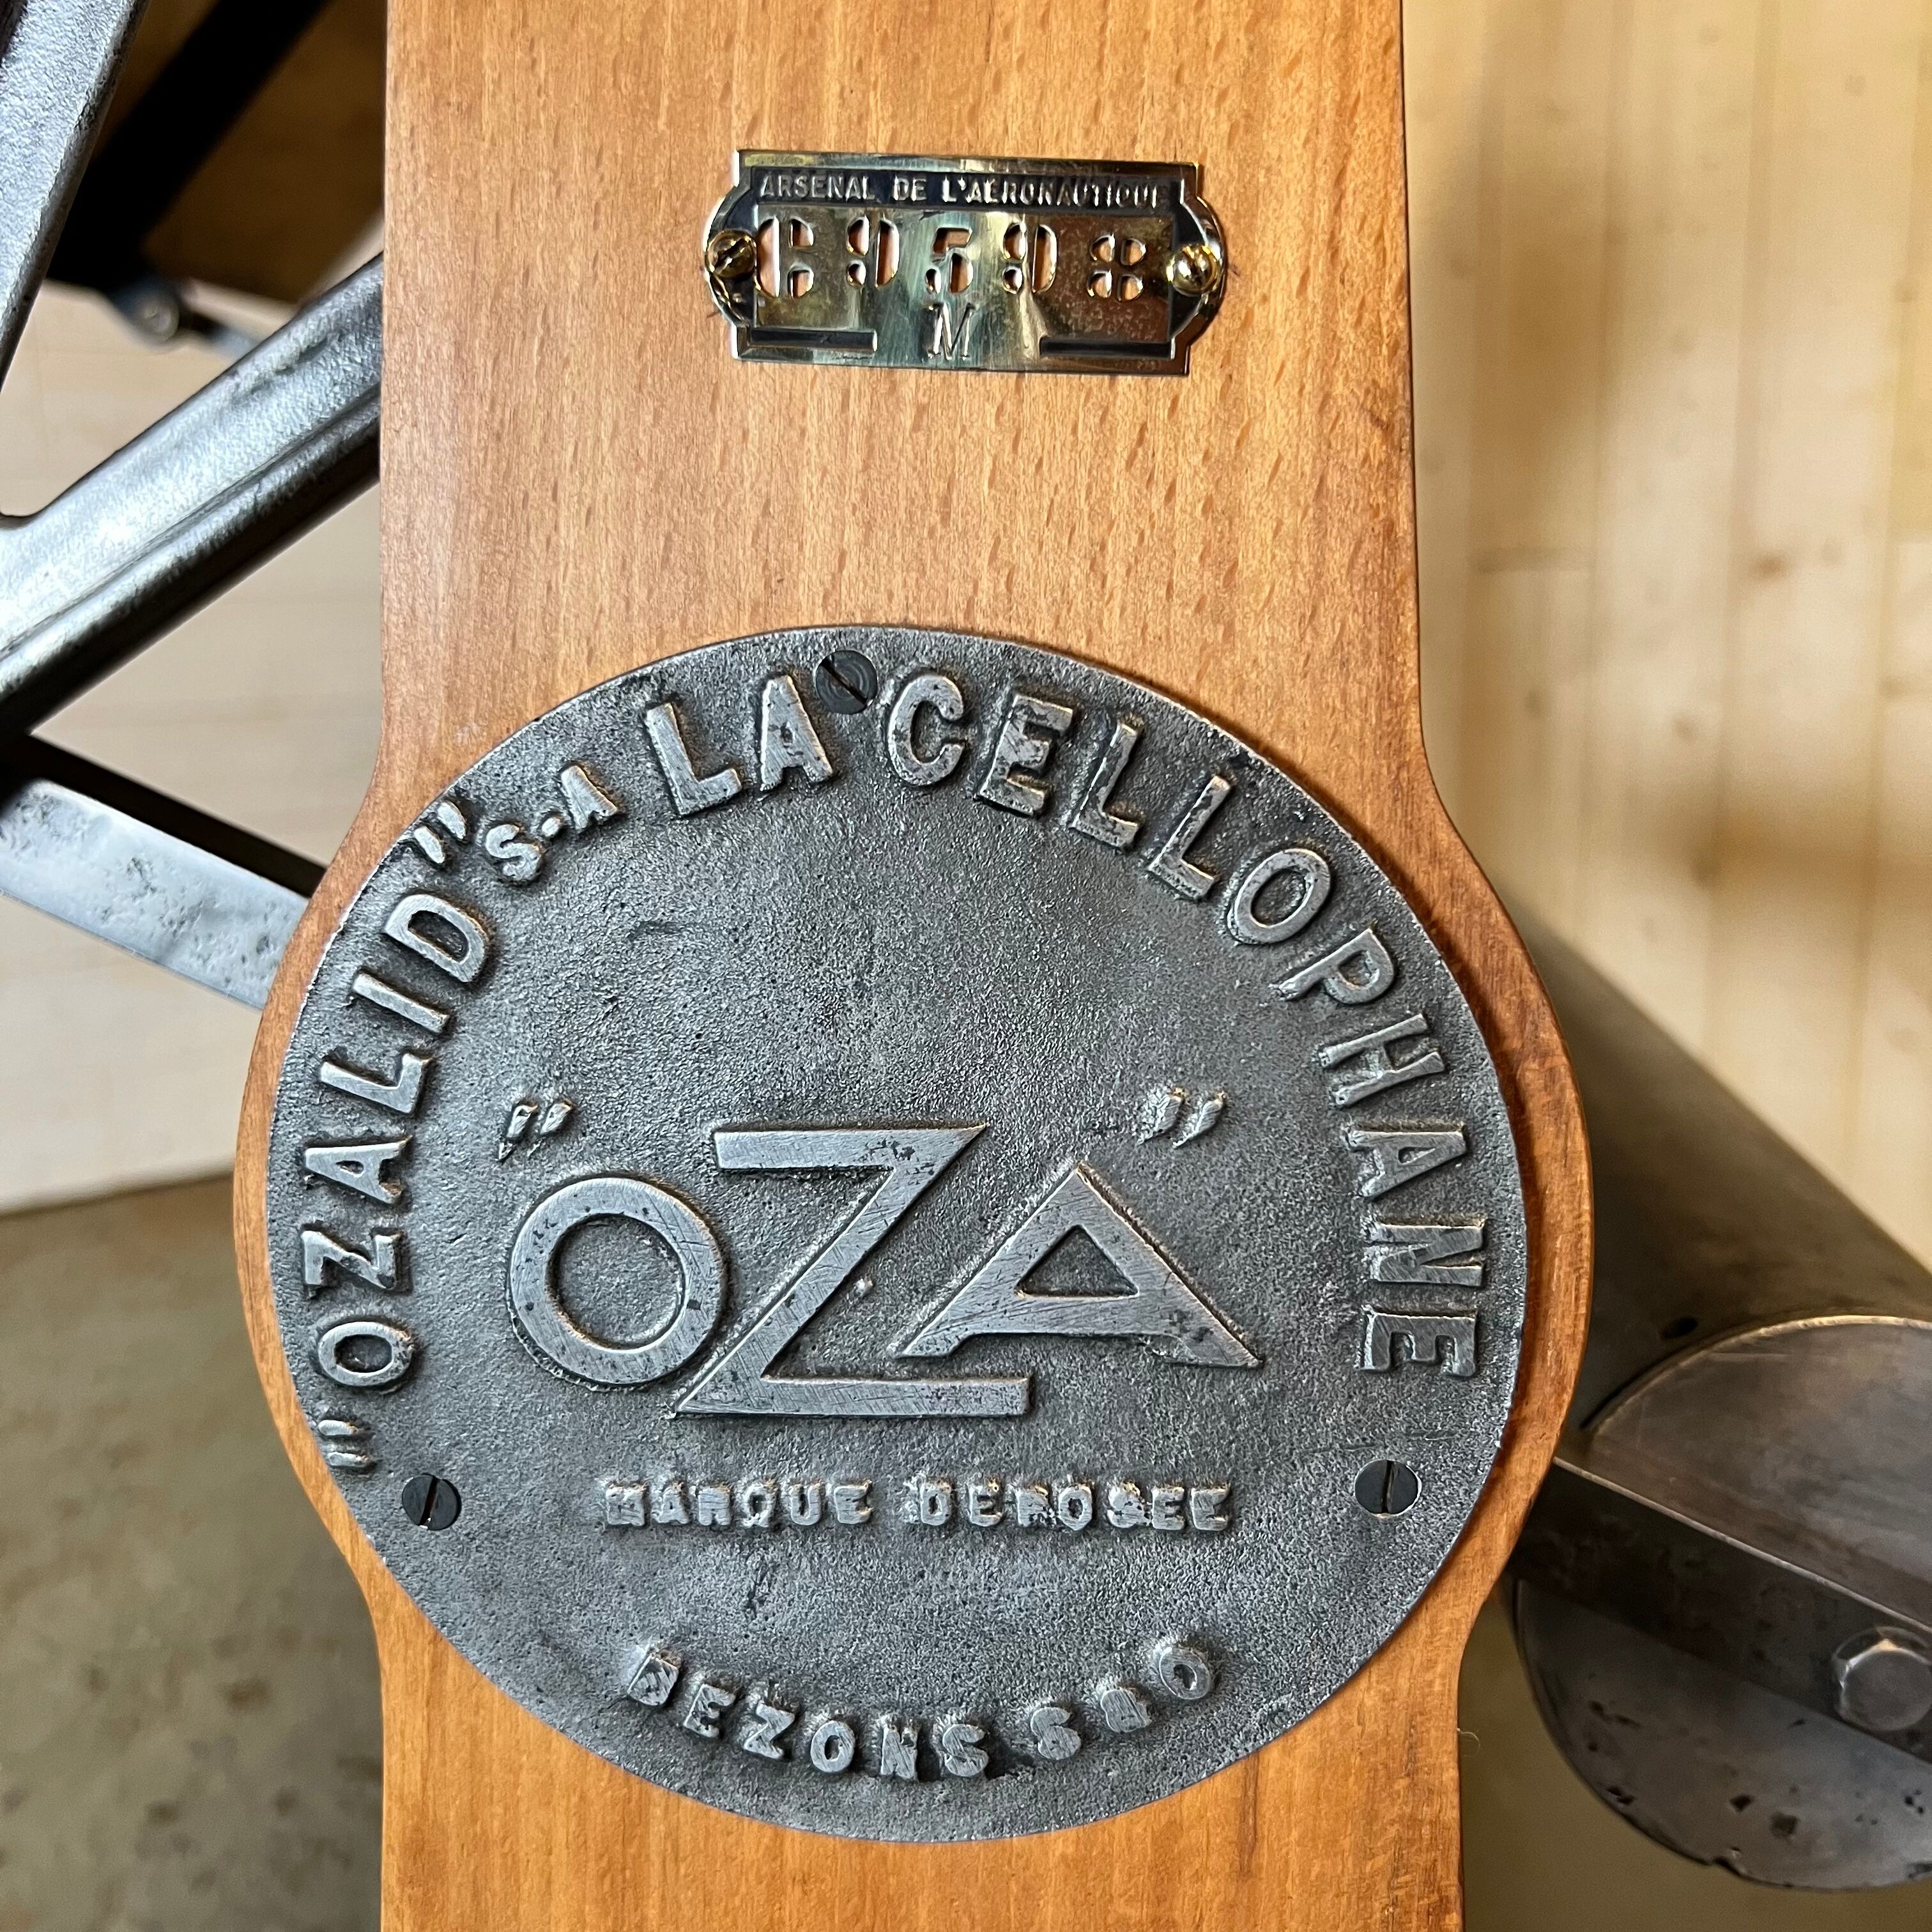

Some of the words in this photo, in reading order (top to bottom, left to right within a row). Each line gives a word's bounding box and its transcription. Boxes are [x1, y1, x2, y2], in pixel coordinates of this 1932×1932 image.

[760, 173, 876, 201] ARSENAL
[893, 175, 927, 202] DE
[927, 302, 977, 360] M
[645, 674, 832, 818] LA
[887, 673, 1487, 1379] CELLOPHANE
[605, 1478, 875, 1529] MARQUE
